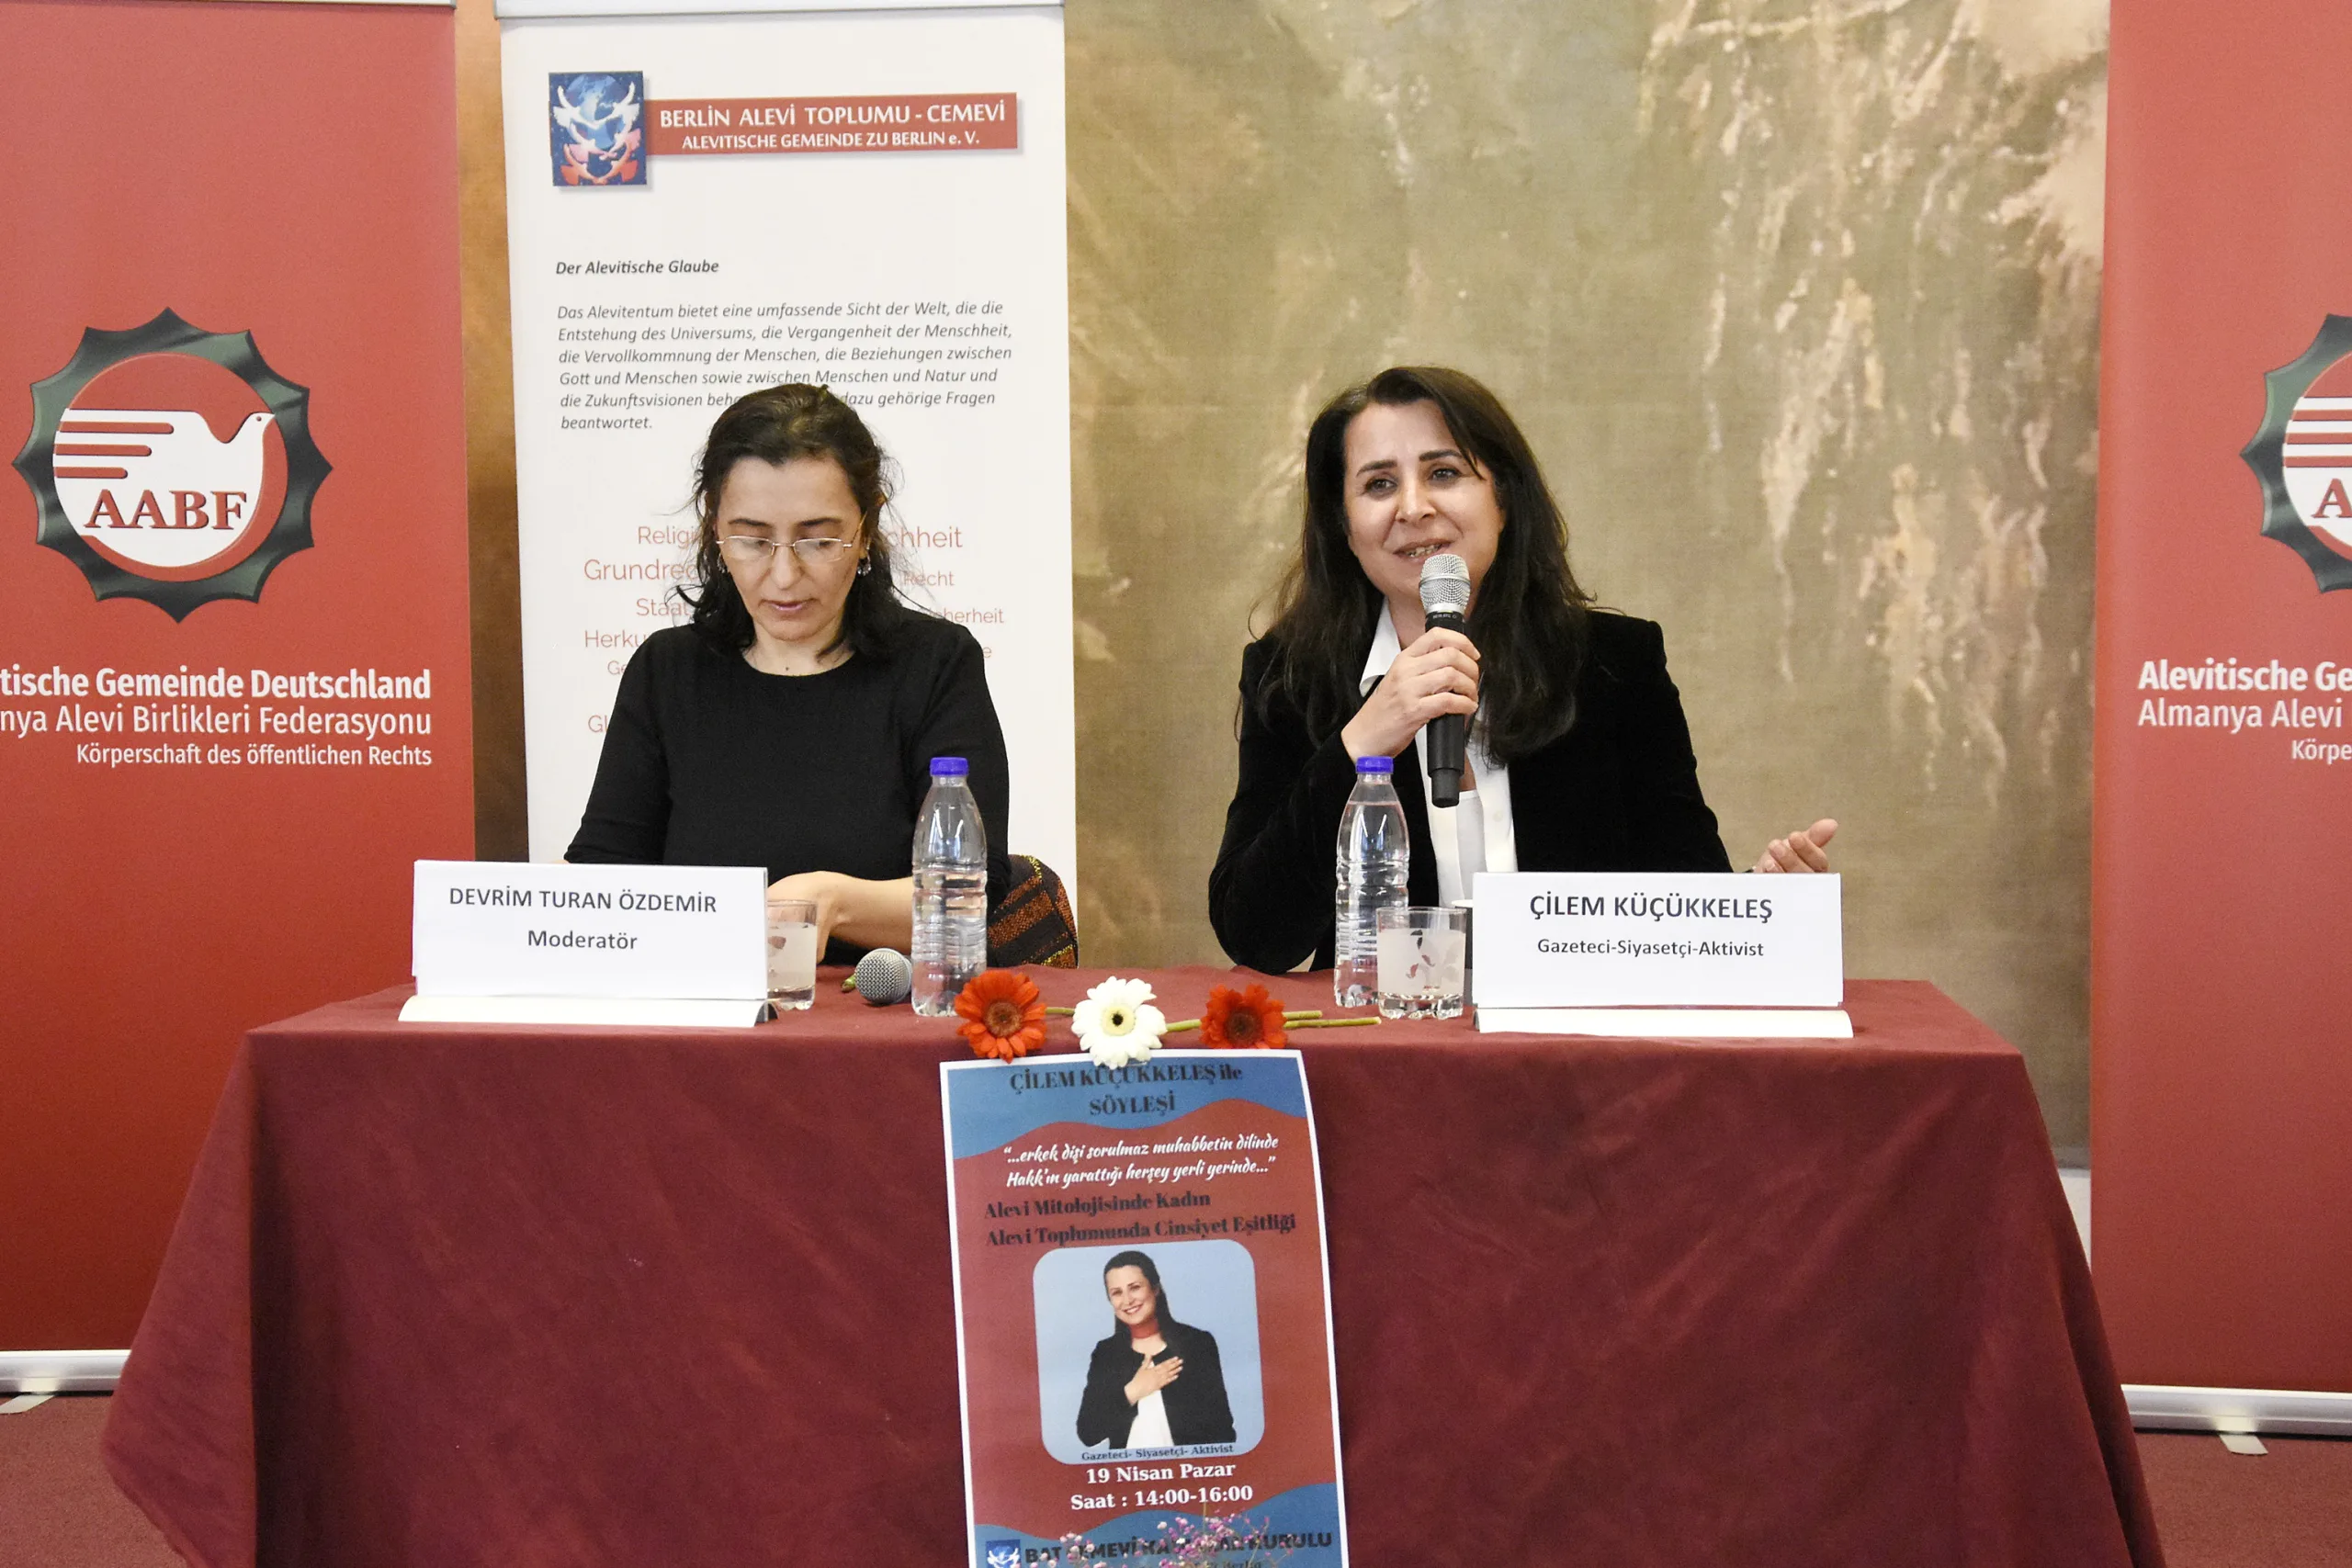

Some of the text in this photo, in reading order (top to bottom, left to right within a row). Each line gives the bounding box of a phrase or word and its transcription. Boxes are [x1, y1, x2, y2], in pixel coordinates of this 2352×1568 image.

[661, 106, 729, 127] BERLİN
[740, 104, 795, 126] ALEVİ
[805, 106, 910, 124] TOPLUMU
[927, 99, 1004, 122] CEMEVİ
[683, 131, 979, 149] ALEVITISCHE GEMEINDE ZU BERLIN e. V.
[556, 260, 718, 274] Der Alevitische Glaube
[558, 301, 1002, 320] Das Alevitentum bietet eine umfassende Sicht der Welt, die die
[559, 323, 1011, 343] Entstehung des Universums, die Vergangenheit der Menschheit,
[559, 346, 1011, 365] die Vervollkommnung der Menschen, die Beziehungen zwischen
[560, 368, 998, 385] Gott und Menschen sowie zwischen Menschen und Natur und
[560, 394, 581, 407] die
[585, 393, 702, 410] Zukunftsvisionen
[878, 391, 941, 408] gehörige
[946, 391, 994, 407] Fragen
[561, 415, 652, 430] beantwortet.
[84, 489, 246, 530] AABF
[585, 630, 646, 649] Herku
[96, 665, 243, 697] Gemeinde
[252, 669, 430, 699] Deutschland
[2138, 658, 2308, 691] Alevitische
[56, 703, 122, 732] Alevi
[134, 704, 249, 733] Birlikleri
[260, 705, 430, 740] Federasyonu
[2138, 697, 2342, 734] Almanya Alevi
[77, 742, 432, 768] Körperschaft des öffentlichen Rechts
[450, 886, 716, 912] DEVRİM TURAN ÖZDEMİR
[1531, 891, 1772, 923] ÇİLEM KÜÇÜKKELEŞ
[528, 931, 637, 949] Moderatör
[1538, 939, 1763, 958] Gazeteci-Siyasetçi-Aktivist
[1010, 1068, 1075, 1094] ÇİLEM
[1220, 1064, 1242, 1080] ile
[1090, 1090, 1175, 1116] SÖYLEŞİ
[1062, 1145, 1083, 1165] dişi
[1087, 1139, 1148, 1159] sorulmaz
[1153, 1135, 1233, 1154] muhabbetin
[1236, 1133, 1278, 1150] dilinde
[1062, 1167, 1123, 1189] yarattığı
[1125, 1163, 1170, 1183] herşey
[1172, 1160, 1204, 1179] yerli
[984, 1191, 1210, 1219] Alevi Mitolojisinde Kadın
[986, 1213, 1295, 1247] Alevi Toplumunda Cinsiyet Eşitliği
[1081, 1445, 1233, 1461] Gazeteci- Siyasetçi- Aktivist
[1087, 1463, 1236, 1483] 19 Nisan Pazar
[1070, 1494, 1115, 1510] Saat
[1135, 1484, 1253, 1506] 14:00-16:00
